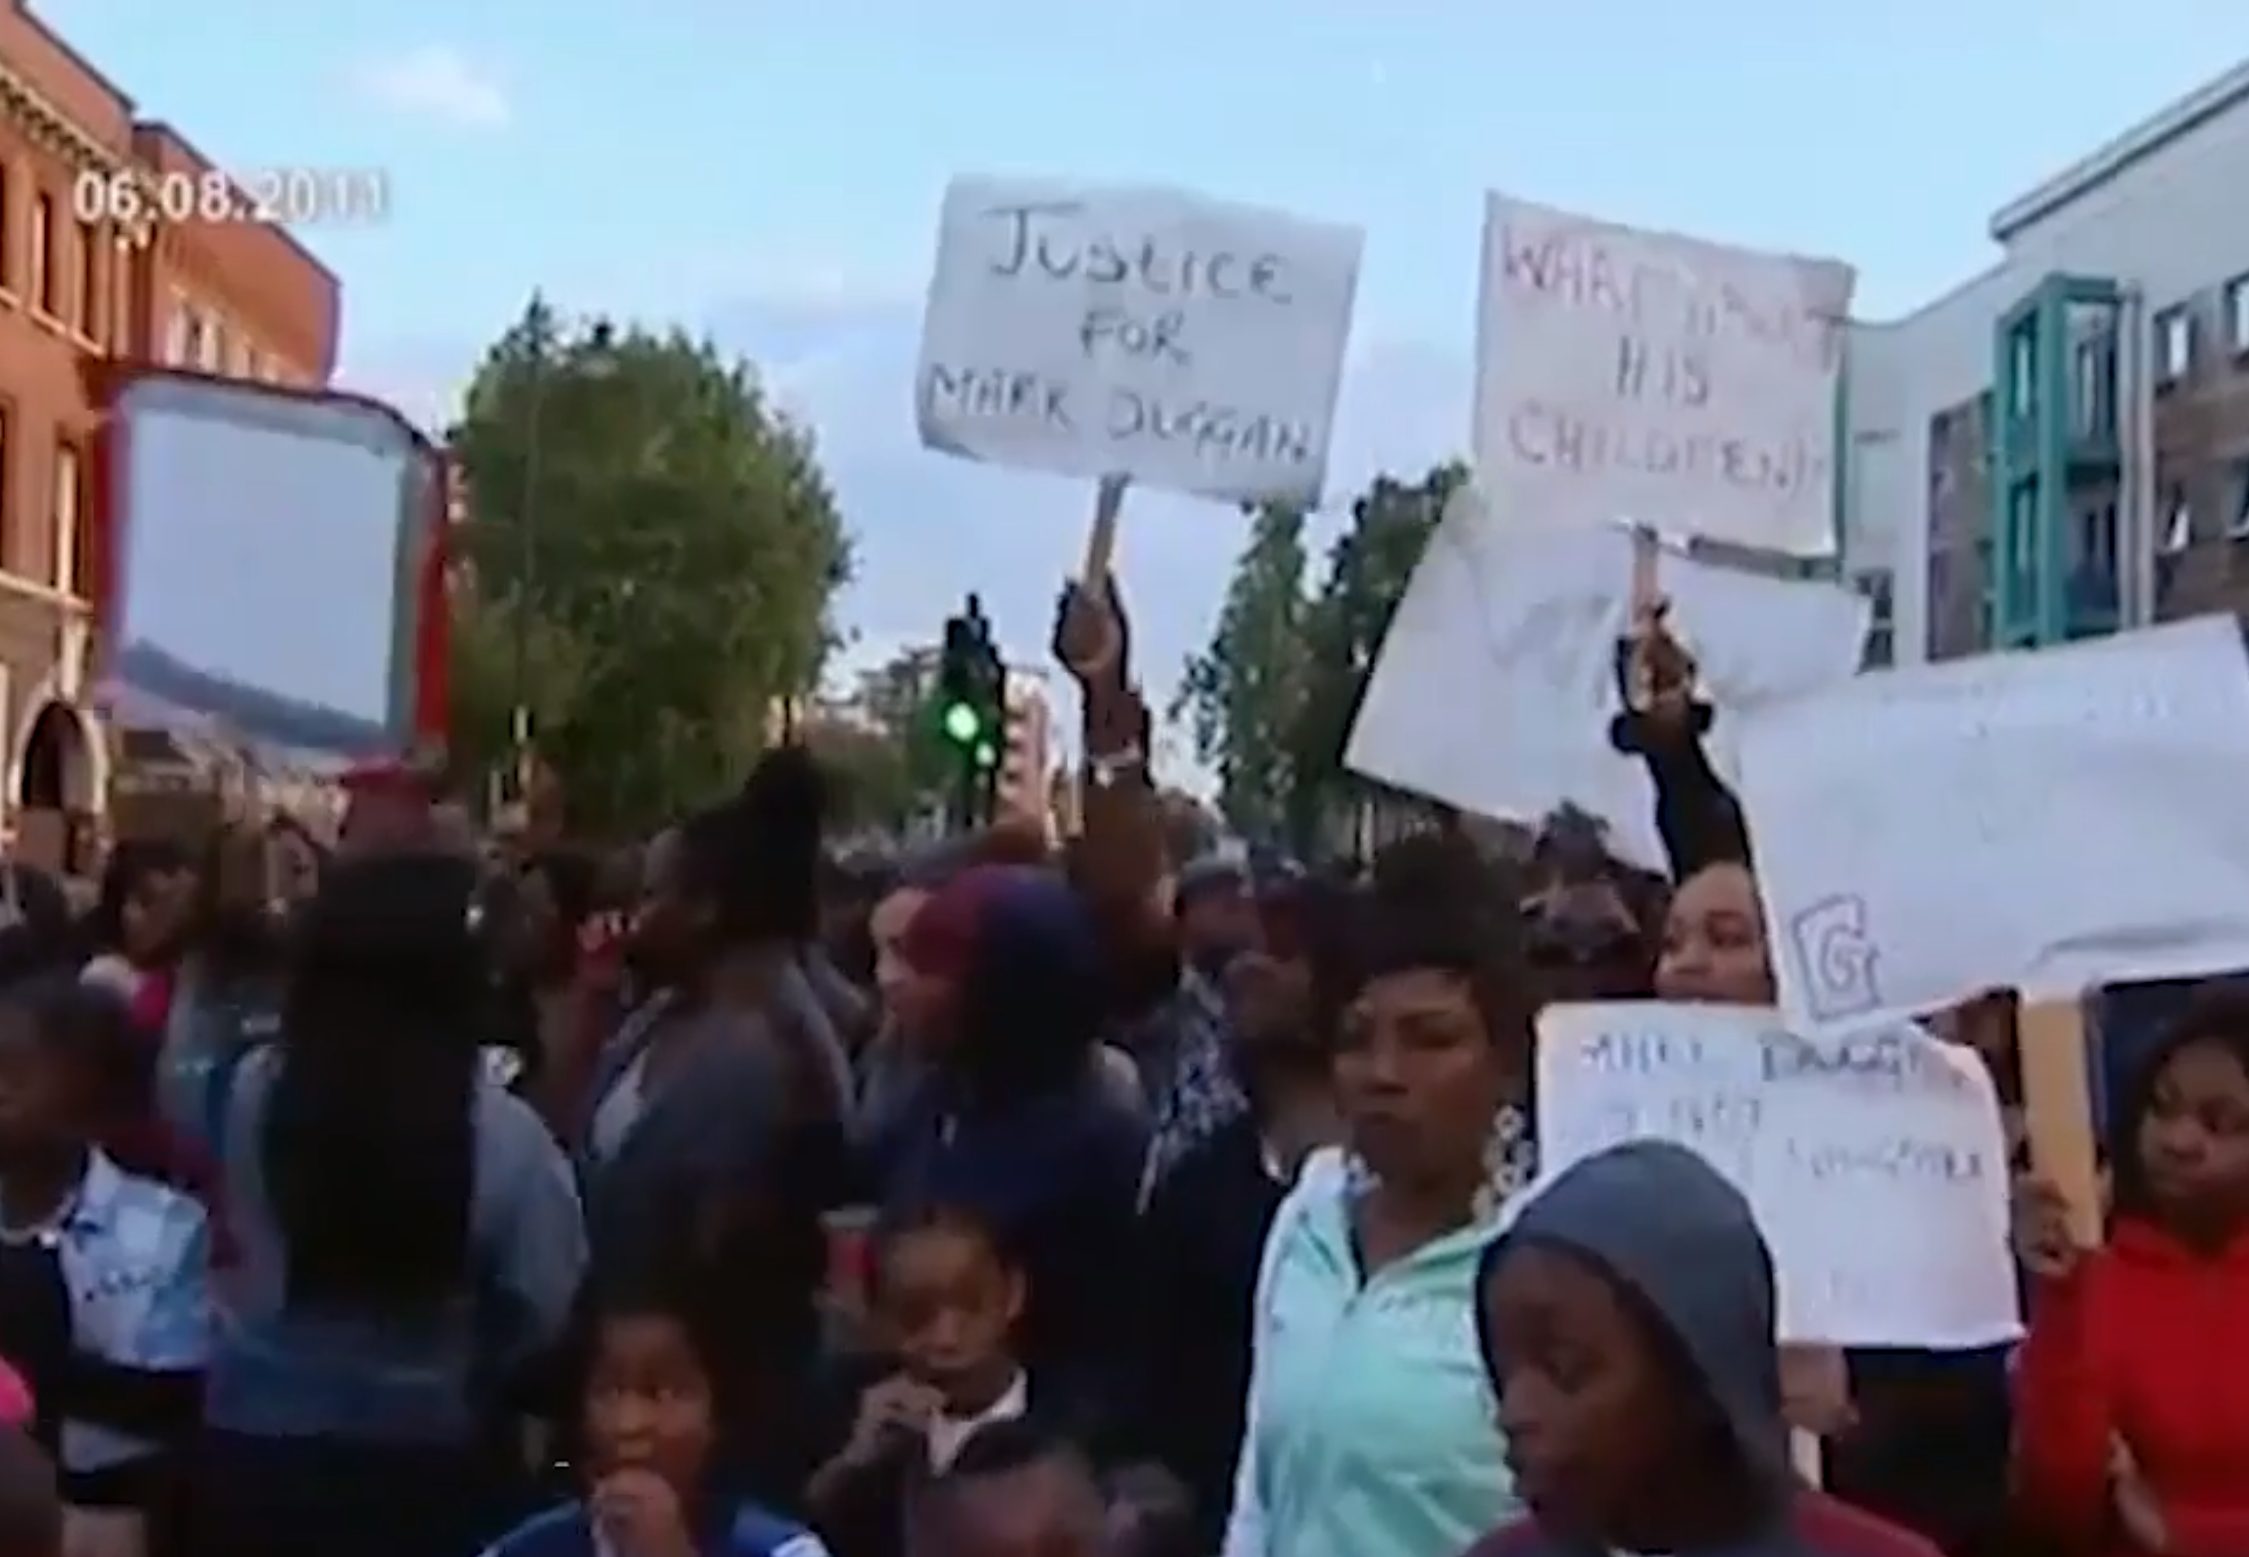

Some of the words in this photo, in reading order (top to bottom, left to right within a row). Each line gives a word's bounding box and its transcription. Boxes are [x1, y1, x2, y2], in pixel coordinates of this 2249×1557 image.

[980, 202, 1293, 304] JUSTICE
[1079, 310, 1189, 365] FOR
[930, 362, 1074, 433] MARK
[1107, 386, 1310, 462] DUGGAN
